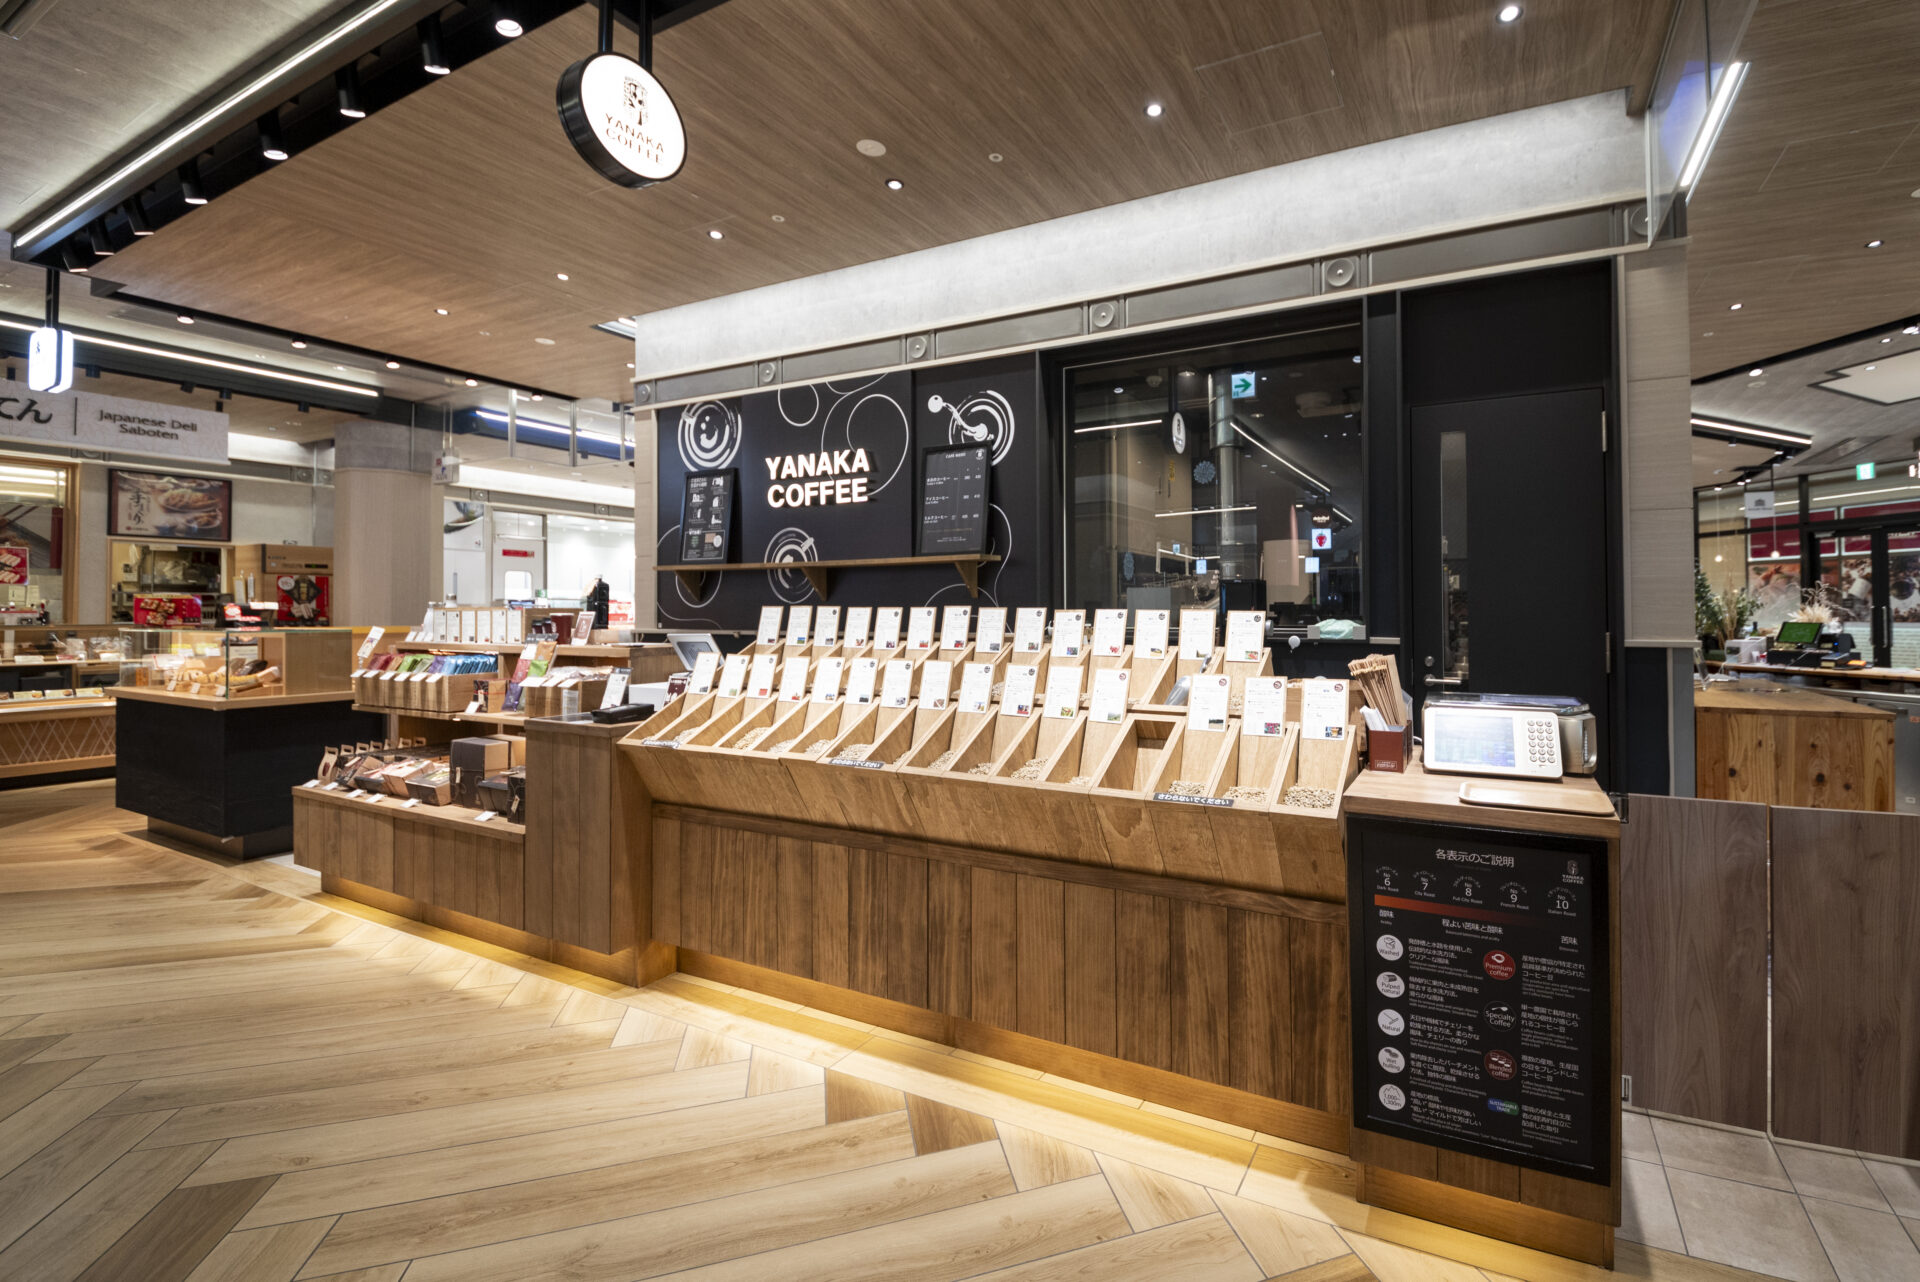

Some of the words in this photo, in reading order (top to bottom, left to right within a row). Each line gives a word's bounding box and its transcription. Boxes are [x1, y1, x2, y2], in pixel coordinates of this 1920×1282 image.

[605, 112, 664, 153] YANAKA
[98, 409, 167, 428] Japanese
[171, 419, 198, 432] Deli
[119, 423, 179, 441] Saboten
[765, 448, 870, 480] YANAKA
[767, 477, 869, 508] COFFEE
[1157, 792, 1230, 805] さわらないでください
[1435, 848, 1515, 868] 各表示のご説明
[1384, 877, 1390, 886] 6
[1421, 882, 1428, 890] 7
[1465, 887, 1472, 897] 8
[1510, 893, 1518, 903] 9
[1556, 900, 1569, 909] 10
[1379, 948, 1400, 957] Washed
[1485, 962, 1513, 972] Premium
[1489, 969, 1509, 977] coffee
[1381, 981, 1400, 990] Pulped
[1381, 988, 1400, 996] natural
[1485, 1010, 1515, 1023] Specialty
[1382, 1023, 1401, 1032] Natural
[1489, 1018, 1511, 1028] Coffee
[1489, 1063, 1513, 1073] Blended
[1491, 1070, 1510, 1079] coffee
